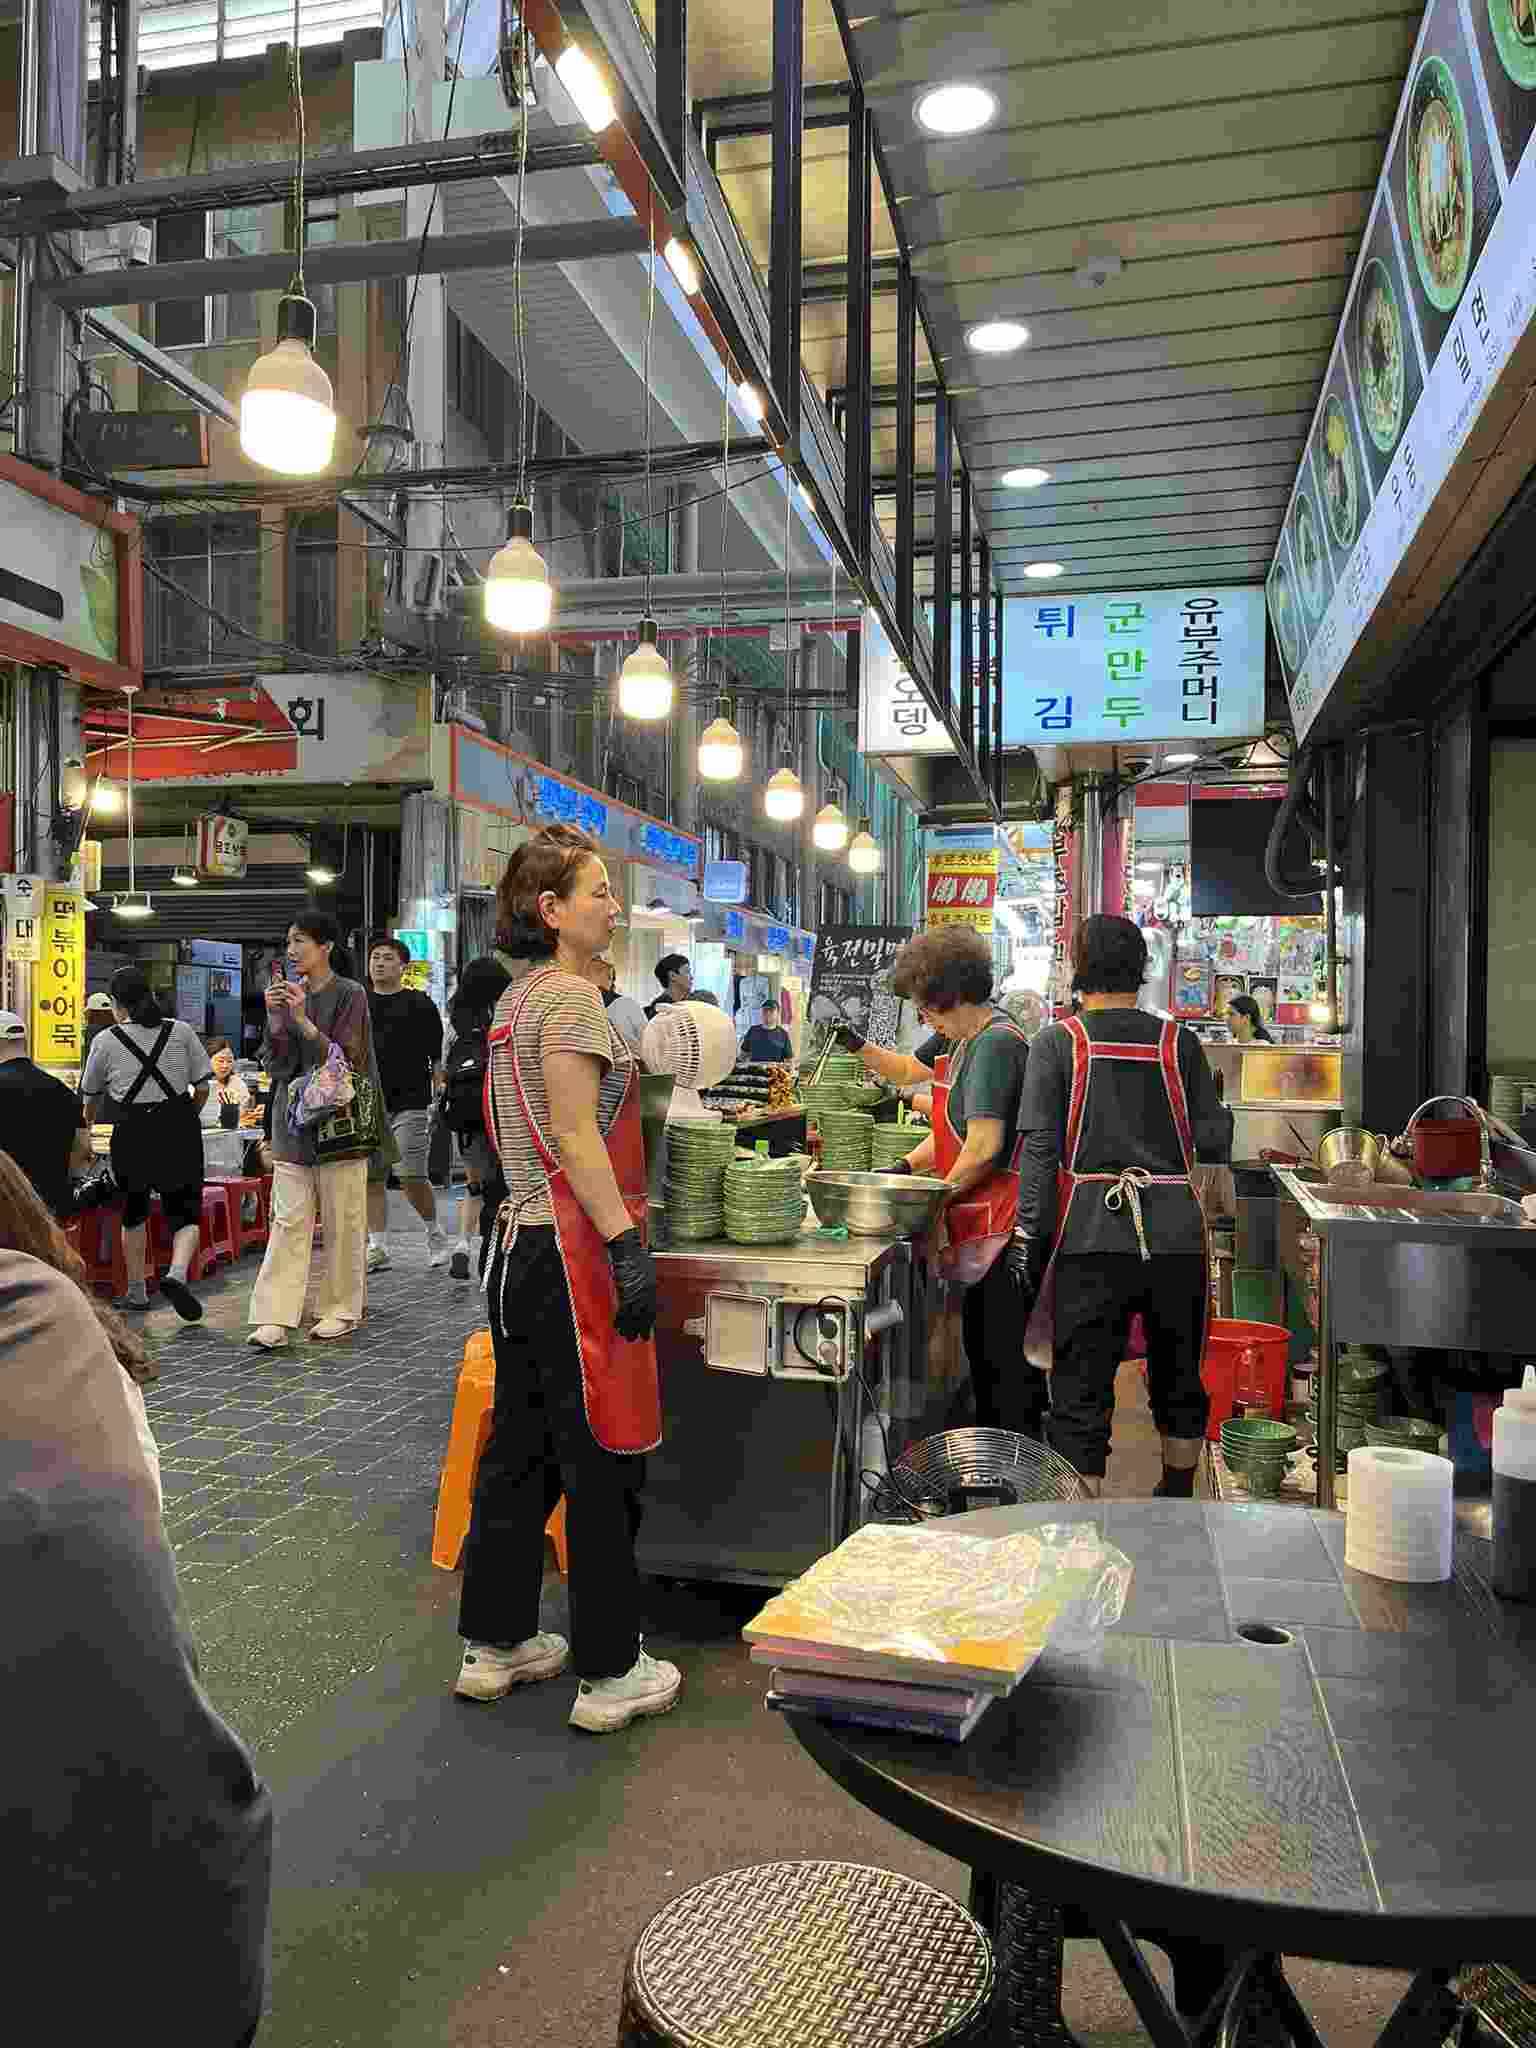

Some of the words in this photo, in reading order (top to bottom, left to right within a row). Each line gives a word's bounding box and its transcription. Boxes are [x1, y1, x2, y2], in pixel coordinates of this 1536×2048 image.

[288, 697, 325, 742] 회
[1033, 604, 1076, 730] 튀김
[1101, 602, 1148, 728] 군만두
[1177, 597, 1224, 725] 유부주머니
